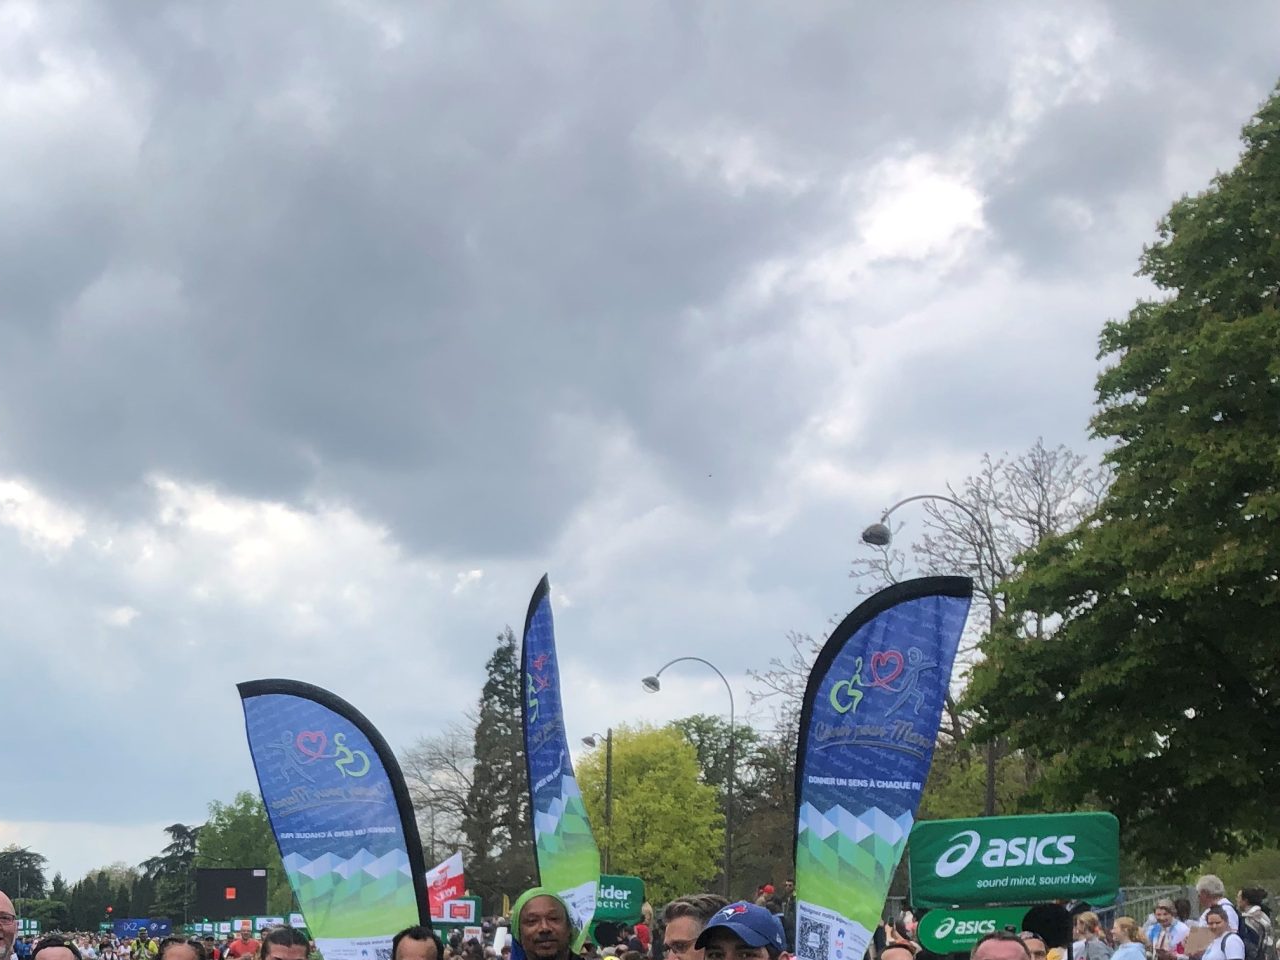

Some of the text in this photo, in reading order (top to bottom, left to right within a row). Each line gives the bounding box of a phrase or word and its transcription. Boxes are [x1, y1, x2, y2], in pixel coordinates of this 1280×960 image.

[808, 775, 836, 786] DONNER
[836, 778, 847, 786] UN
[848, 779, 868, 788] SENS
[869, 778, 875, 788] À
[876, 780, 911, 790] CHAQUE
[982, 835, 1075, 868] asics
[976, 872, 1097, 888] sound mind, sound body
[597, 901, 630, 909] ectric
[954, 919, 996, 935] asics
